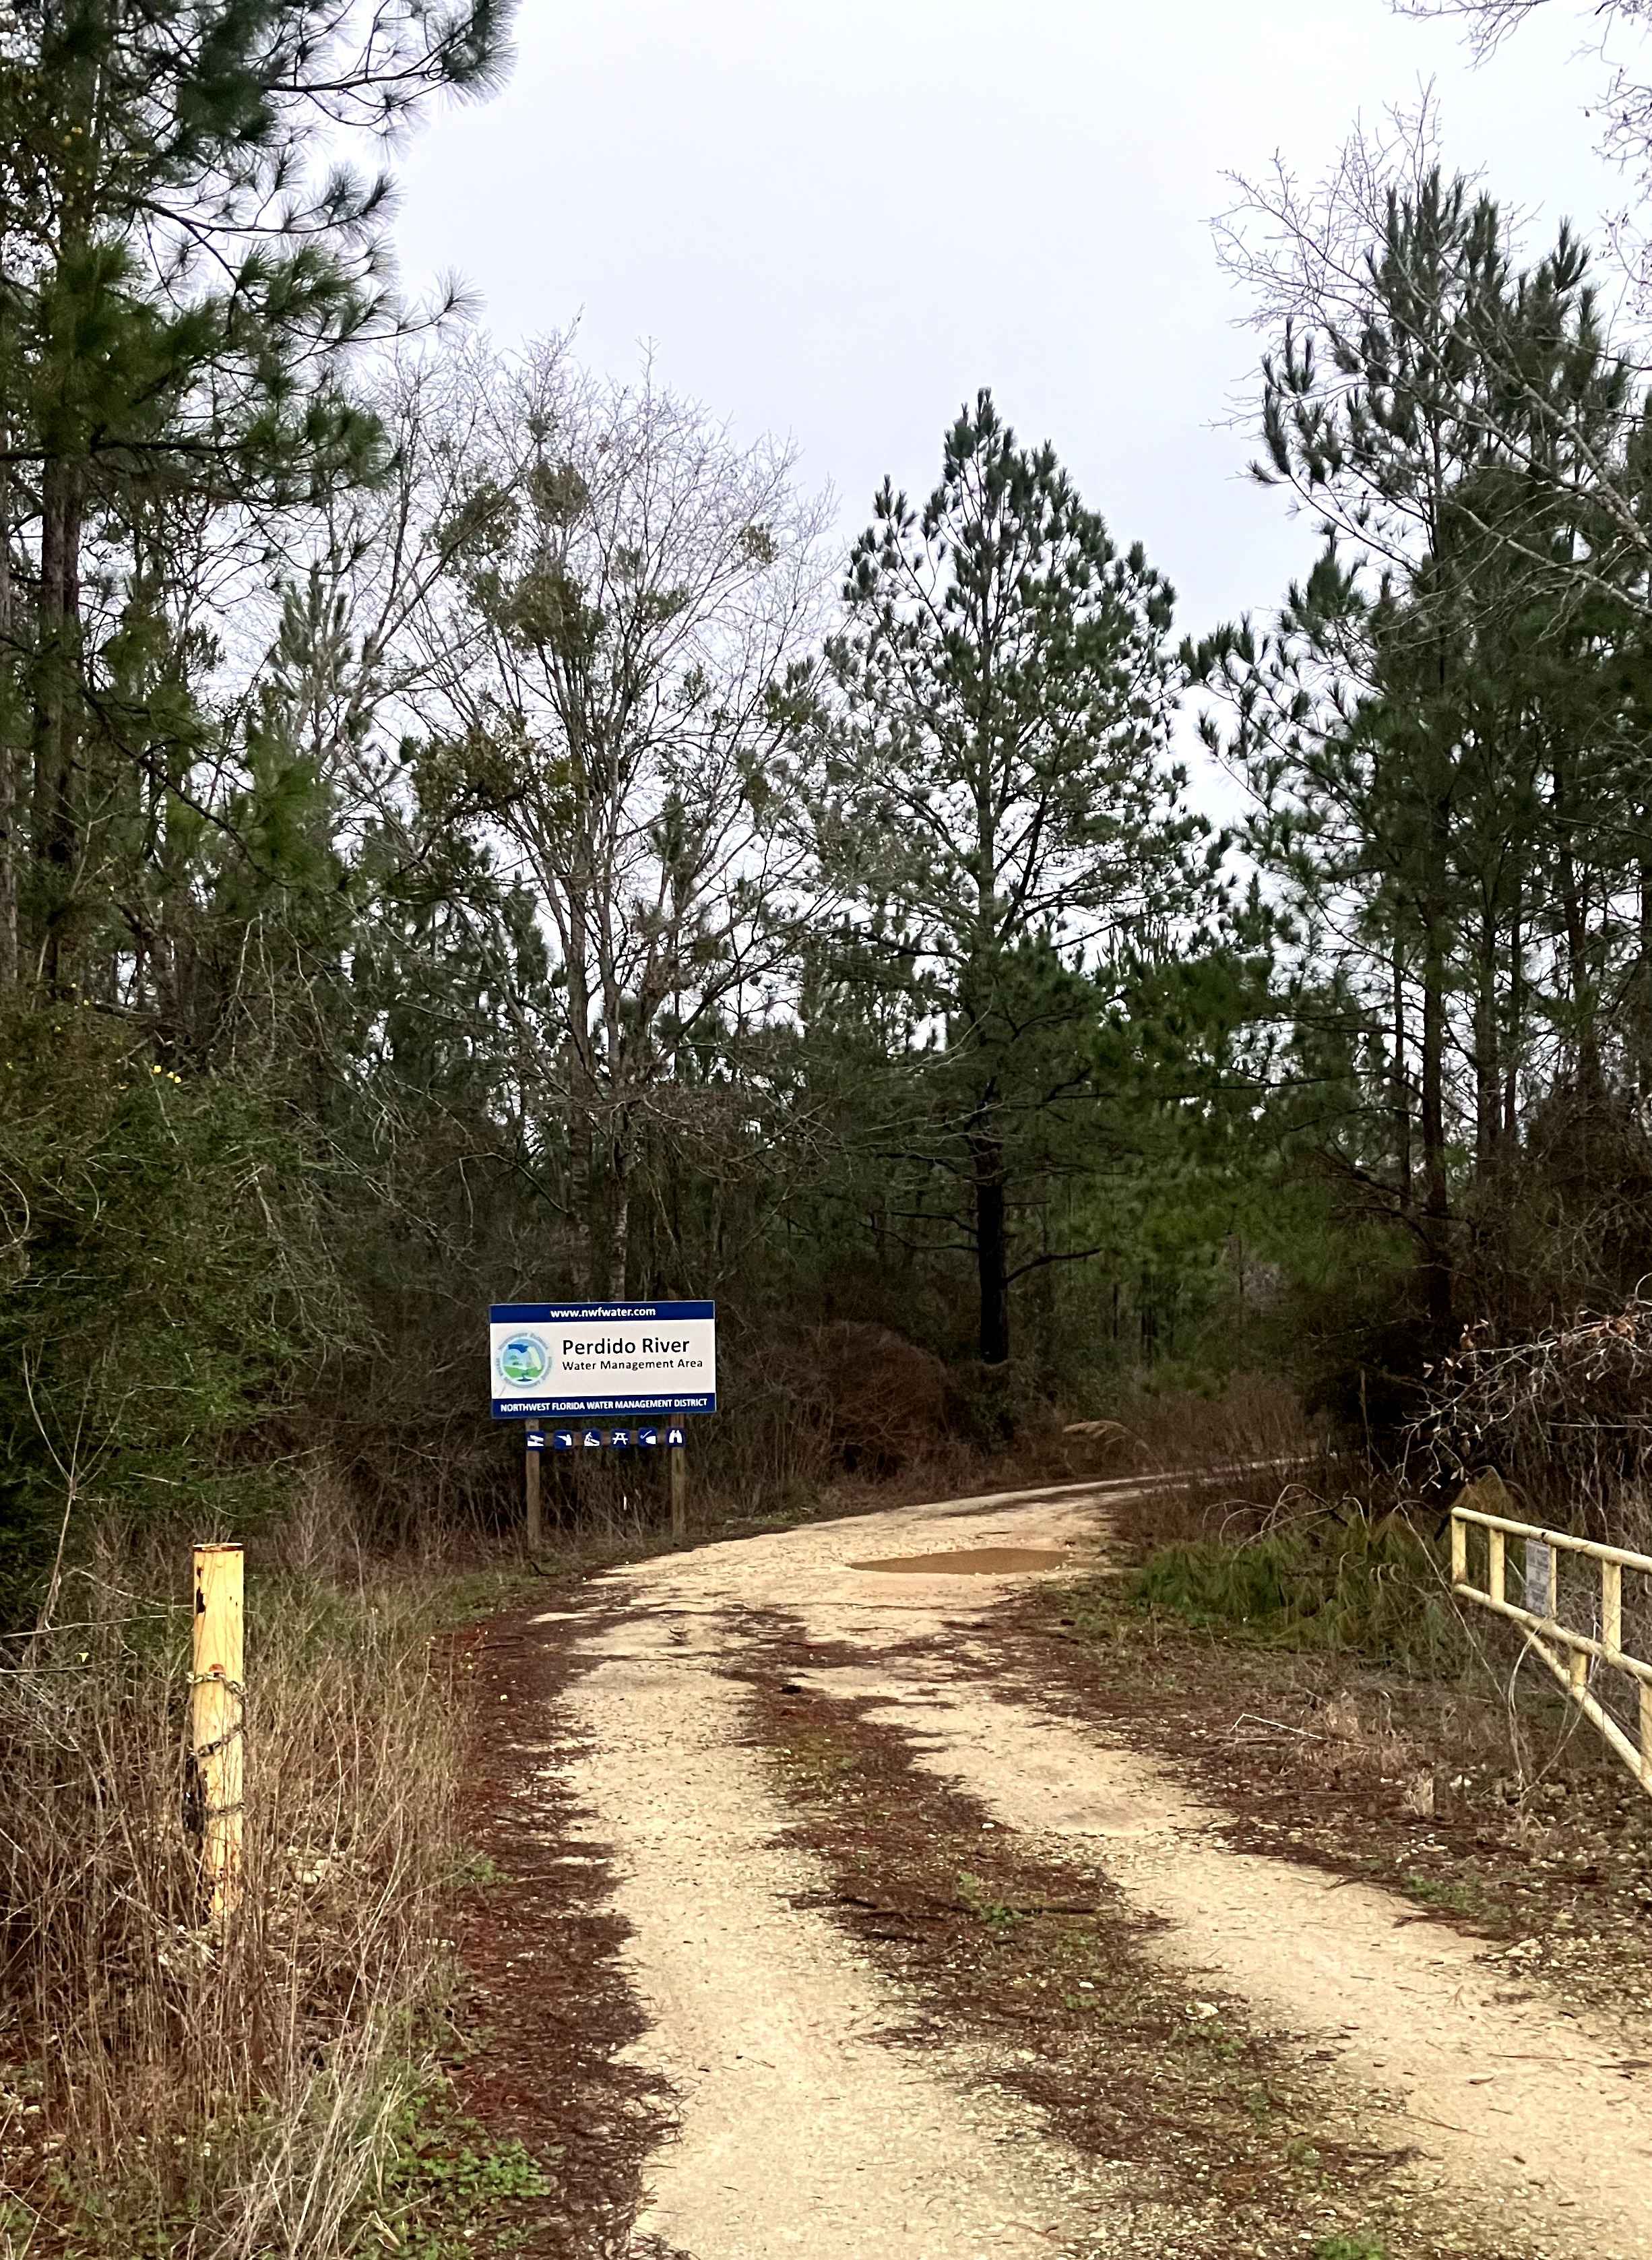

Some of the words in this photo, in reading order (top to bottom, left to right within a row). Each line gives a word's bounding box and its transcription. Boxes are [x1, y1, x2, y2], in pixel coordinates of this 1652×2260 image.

[550, 1307, 656, 1318] www.nwfwater.com
[563, 1338, 636, 1355] Perdido
[642, 1337, 690, 1354] River
[562, 1360, 597, 1371] Water
[600, 1360, 674, 1371] Management
[678, 1359, 703, 1369] Area
[501, 1402, 550, 1412] NORTHWEST
[552, 1401, 585, 1411] FLORIDA
[587, 1400, 613, 1410] WATER
[614, 1399, 672, 1409] MANAGEMENT
[674, 1398, 707, 1408] DISTRICT
